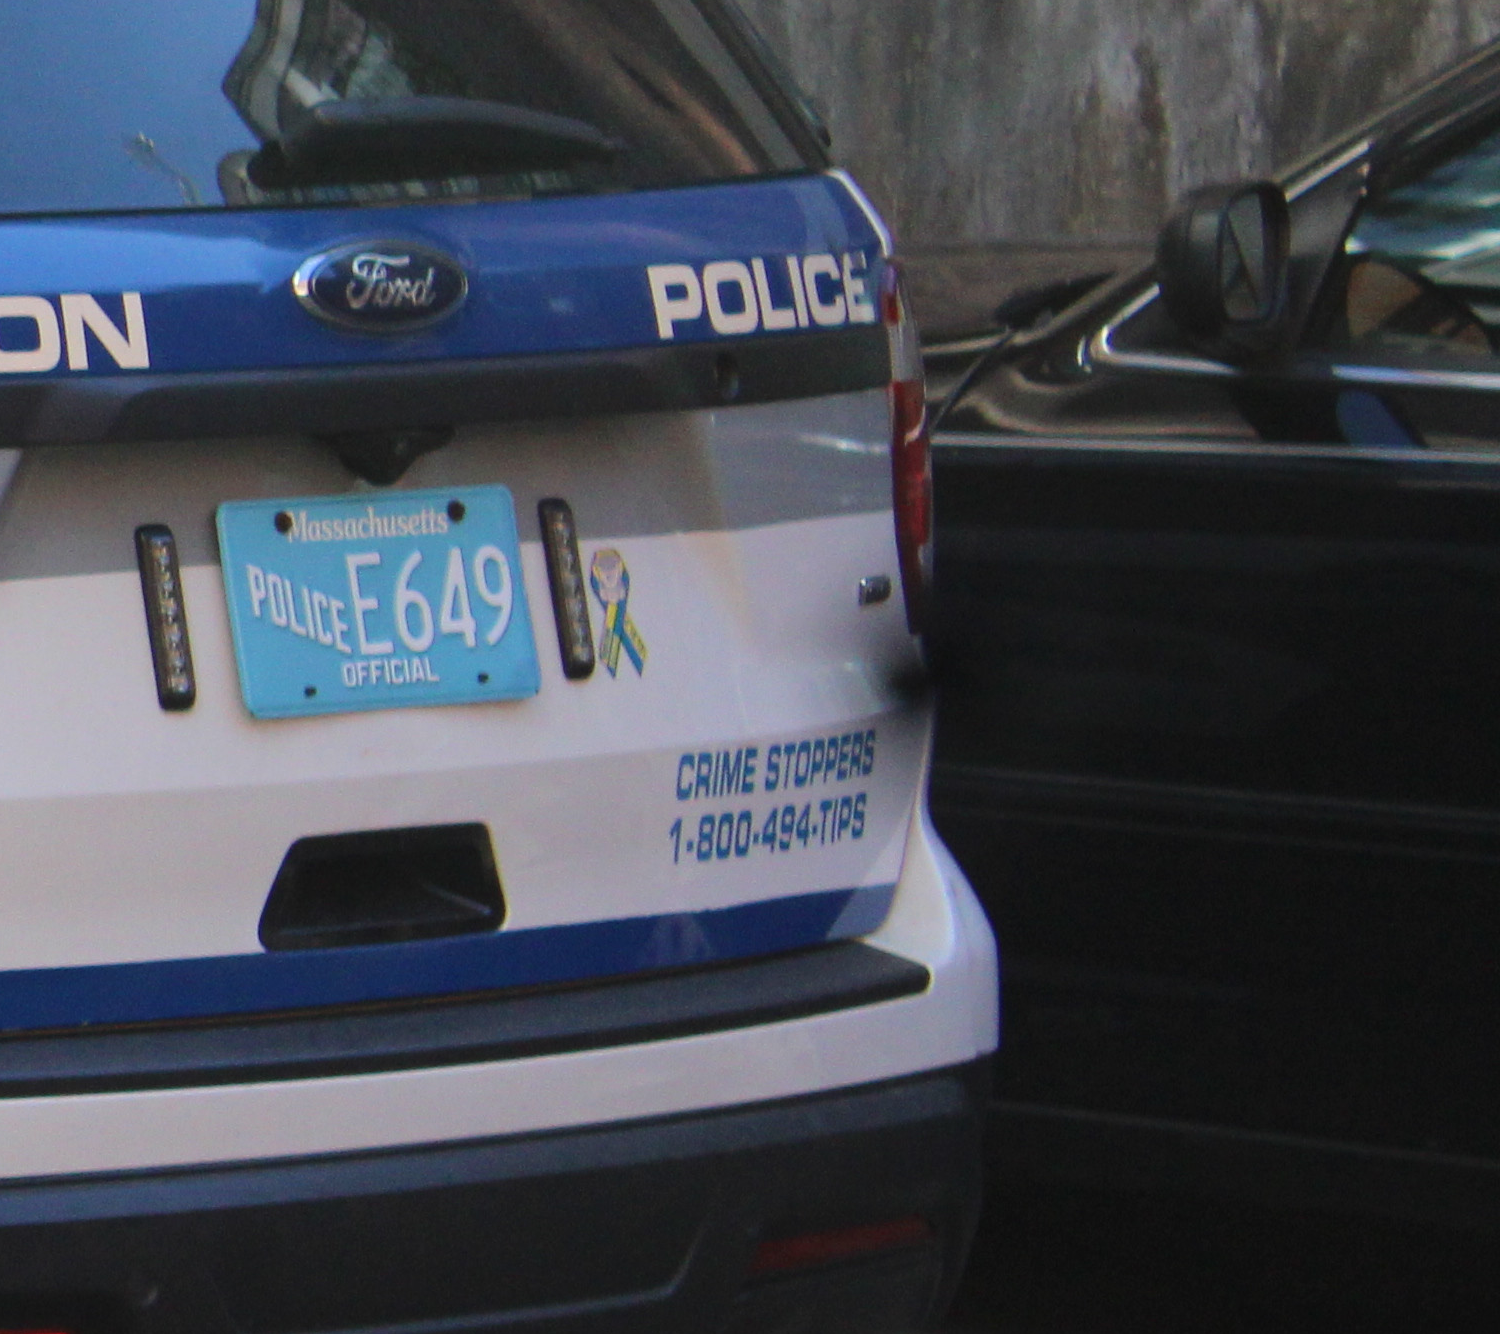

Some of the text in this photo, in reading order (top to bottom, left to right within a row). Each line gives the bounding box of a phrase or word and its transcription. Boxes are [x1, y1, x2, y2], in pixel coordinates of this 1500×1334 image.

[346, 252, 436, 310] Ford
[647, 249, 876, 340] POLICE
[287, 506, 449, 543] Massachusetts
[247, 564, 353, 654] POLICE
[346, 545, 514, 656] E649
[342, 656, 440, 688] OFFICIAL
[676, 729, 876, 800] CRIME STOPPERS
[669, 791, 867, 865] 1-800-494-TIPS
